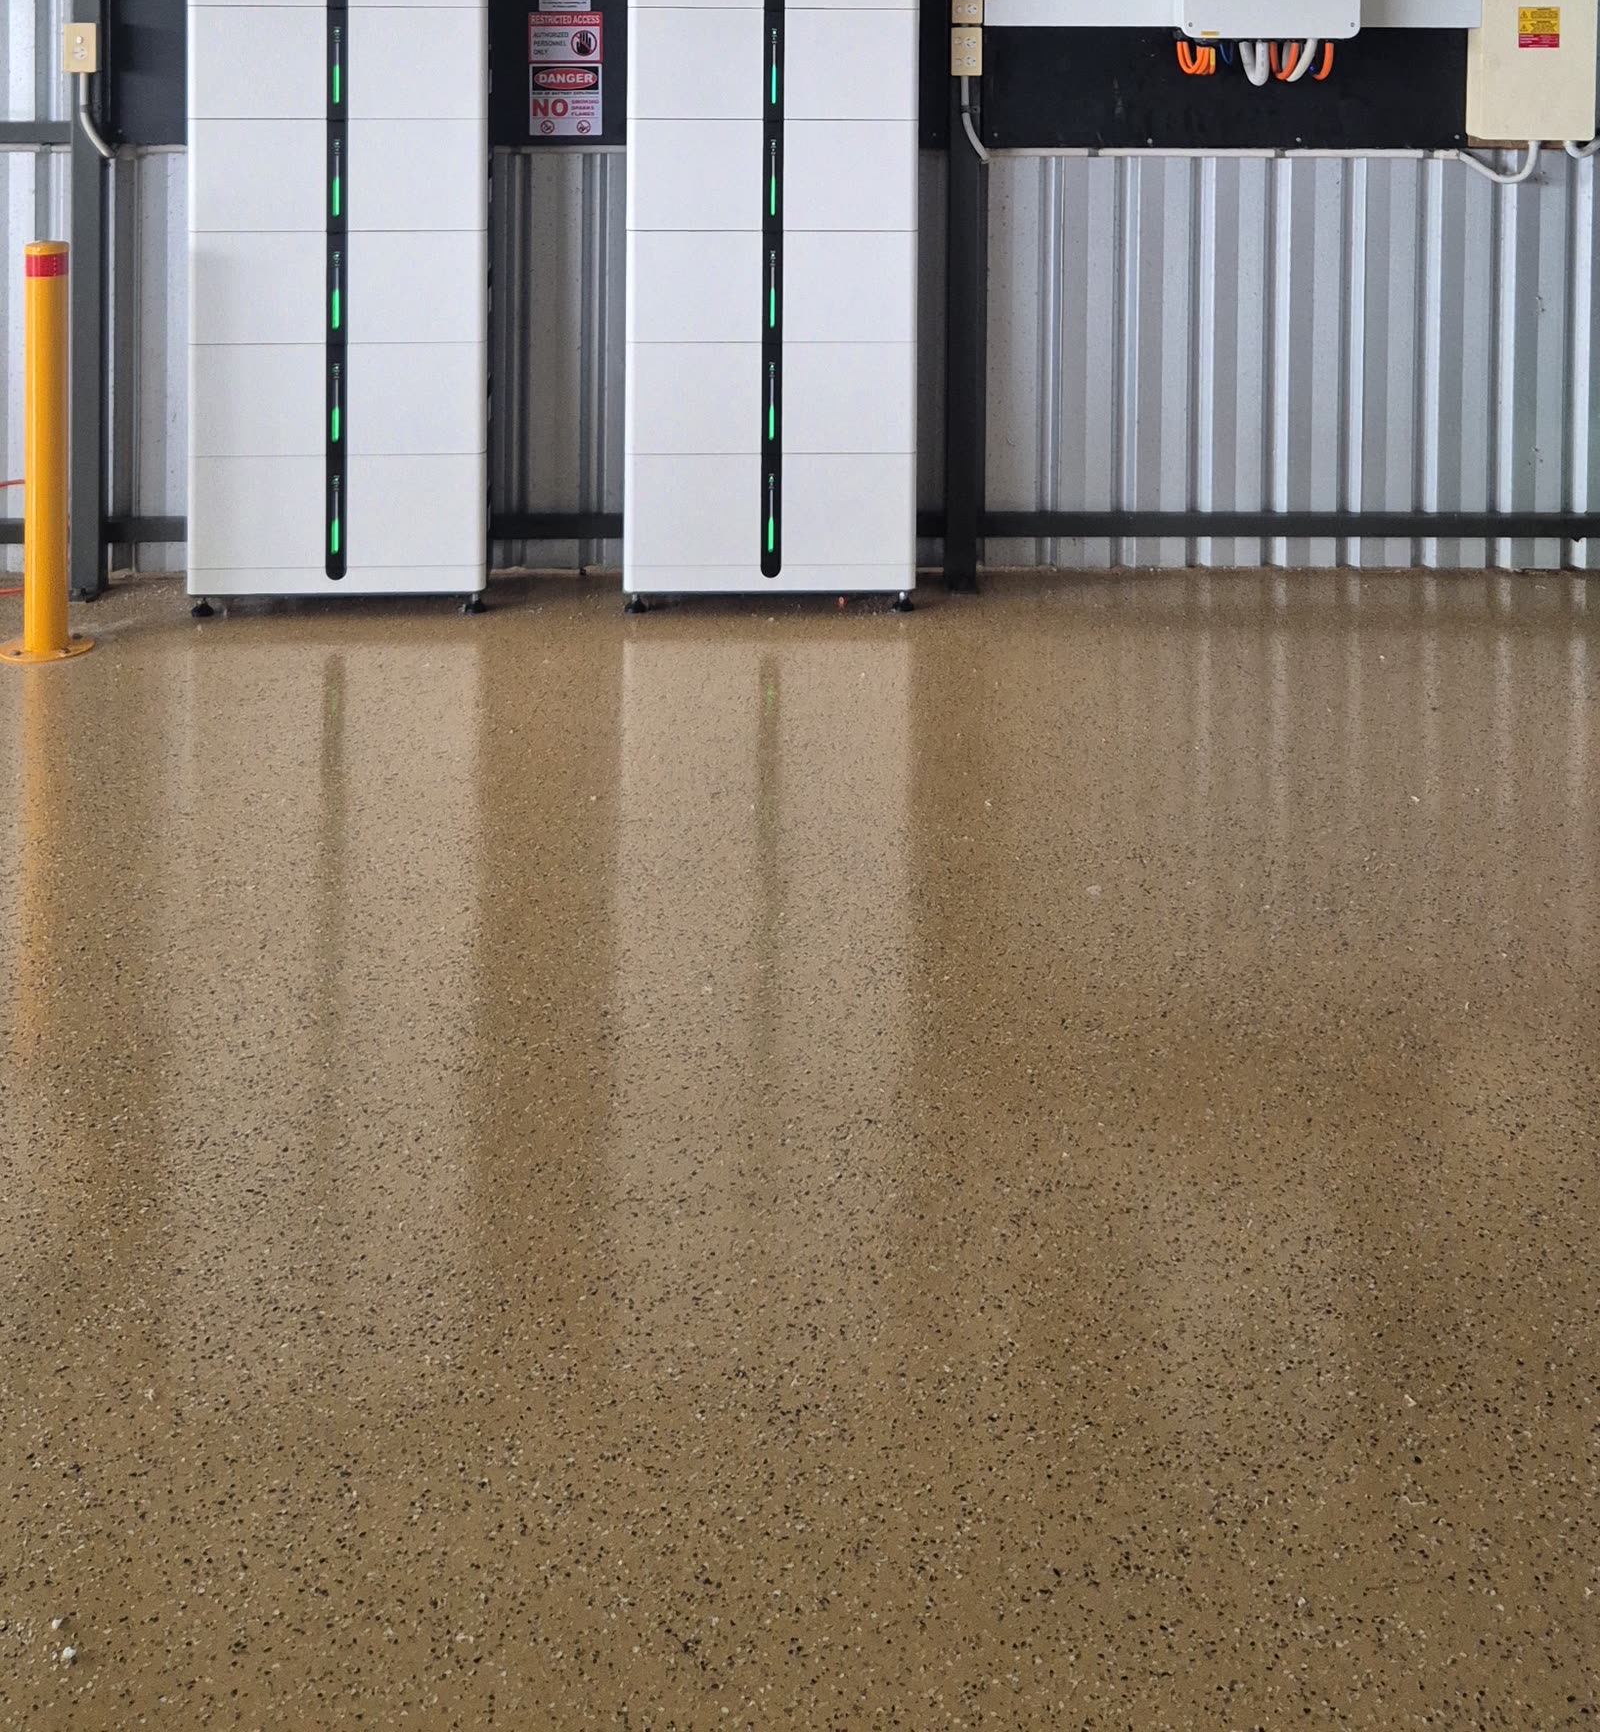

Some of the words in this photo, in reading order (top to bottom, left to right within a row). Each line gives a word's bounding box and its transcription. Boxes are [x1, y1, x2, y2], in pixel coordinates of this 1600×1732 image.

[531, 15, 572, 24] RESTRICTED
[573, 15, 600, 24] ACCESS
[539, 73, 593, 83] DANGER
[532, 98, 569, 117] NO
